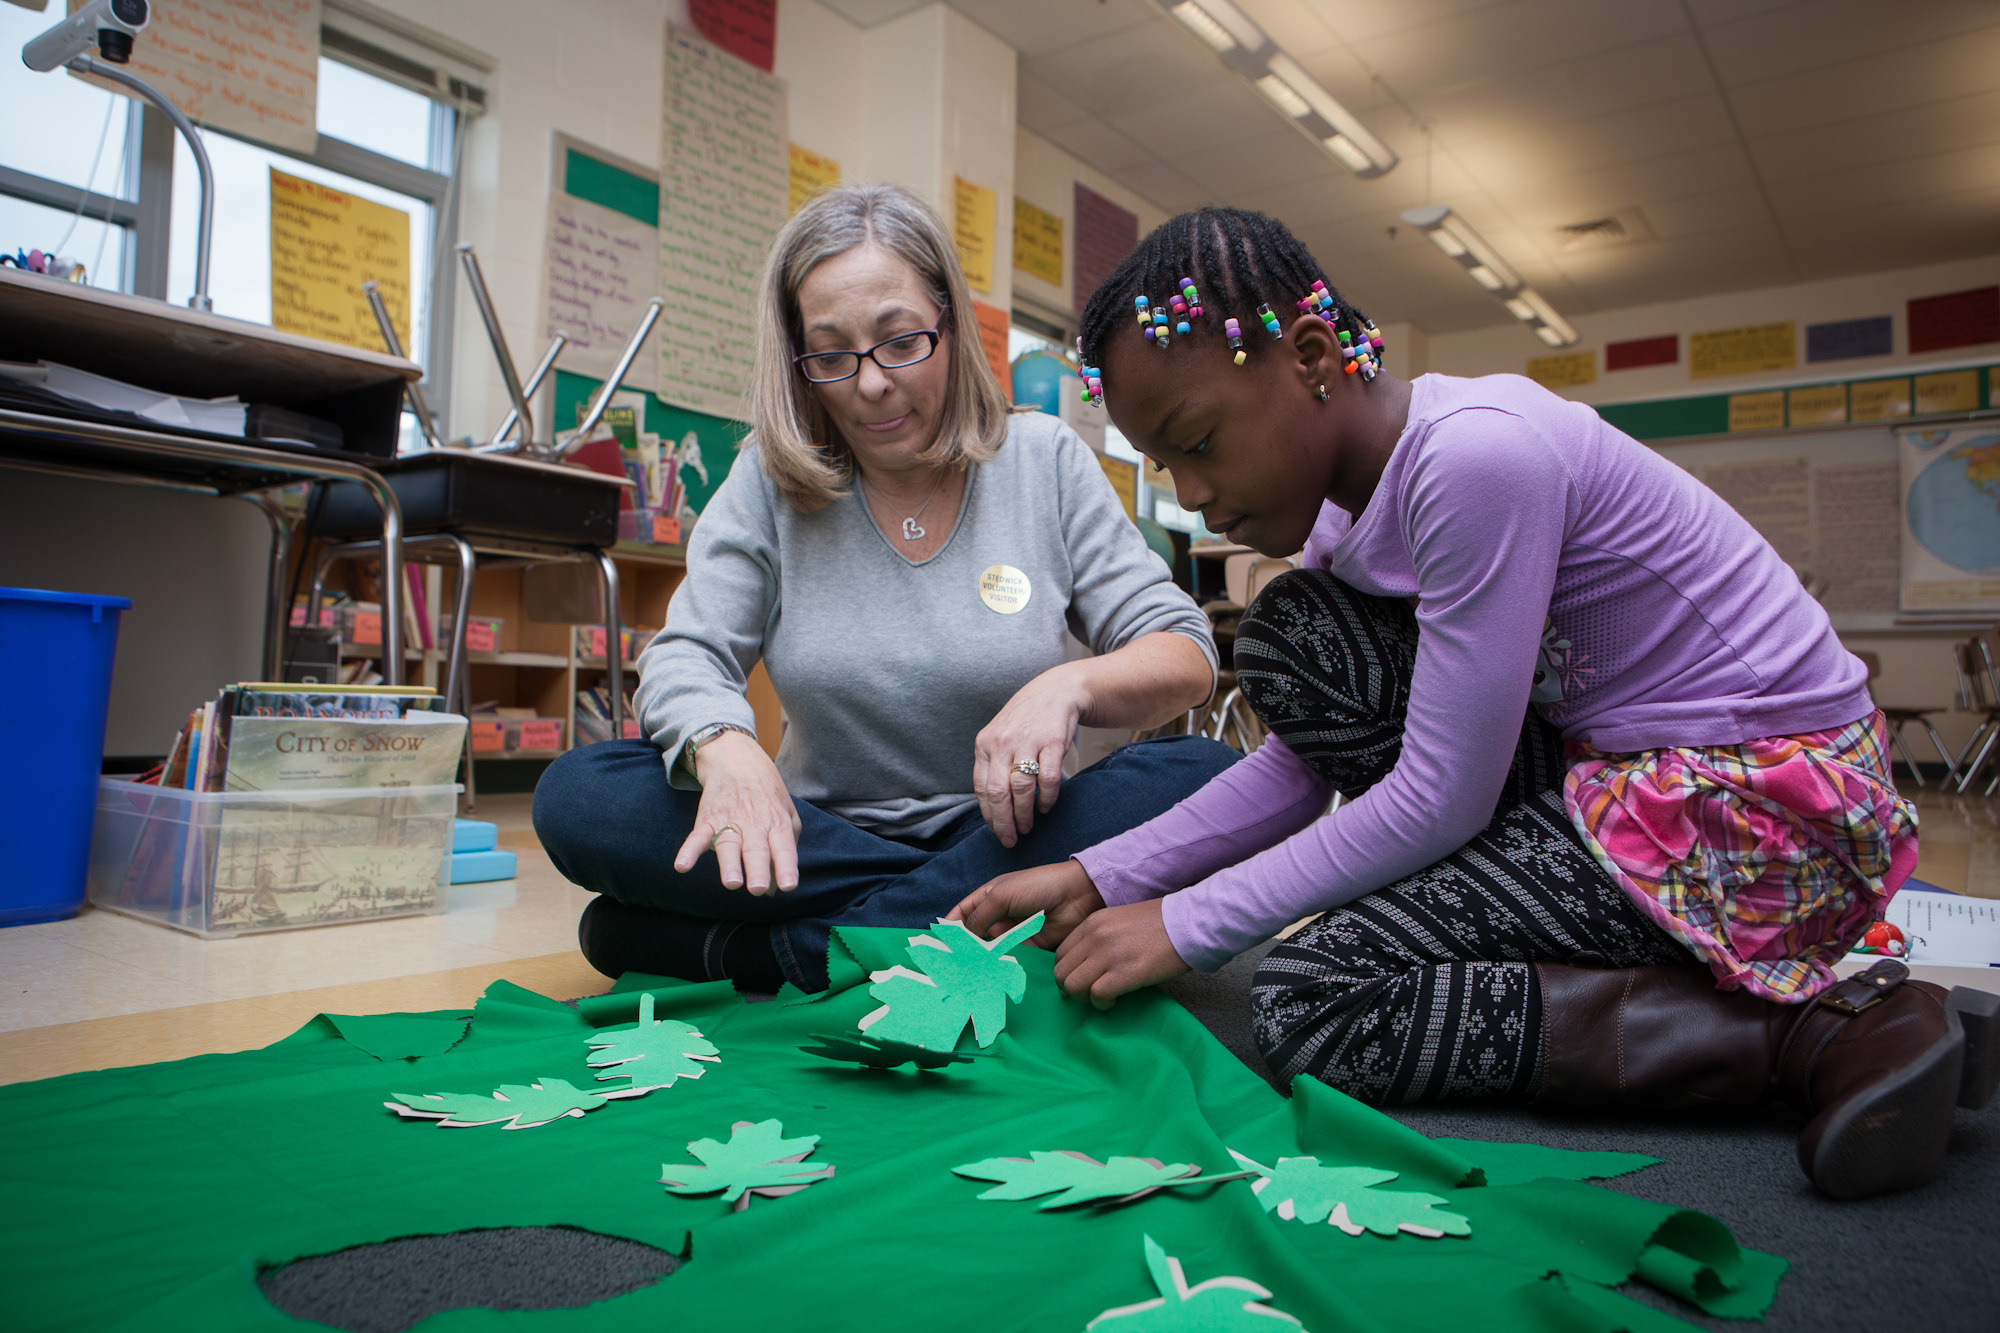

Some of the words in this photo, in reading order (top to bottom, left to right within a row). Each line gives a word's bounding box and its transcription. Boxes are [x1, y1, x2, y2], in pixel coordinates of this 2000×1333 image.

[987, 573, 1023, 585] STEDWICK
[983, 581, 1024, 594] VOLUNTEER
[989, 593, 1018, 604] VISITOR
[276, 731, 333, 754] CITY
[334, 737, 357, 752] OF
[363, 731, 426, 752] SNOW
